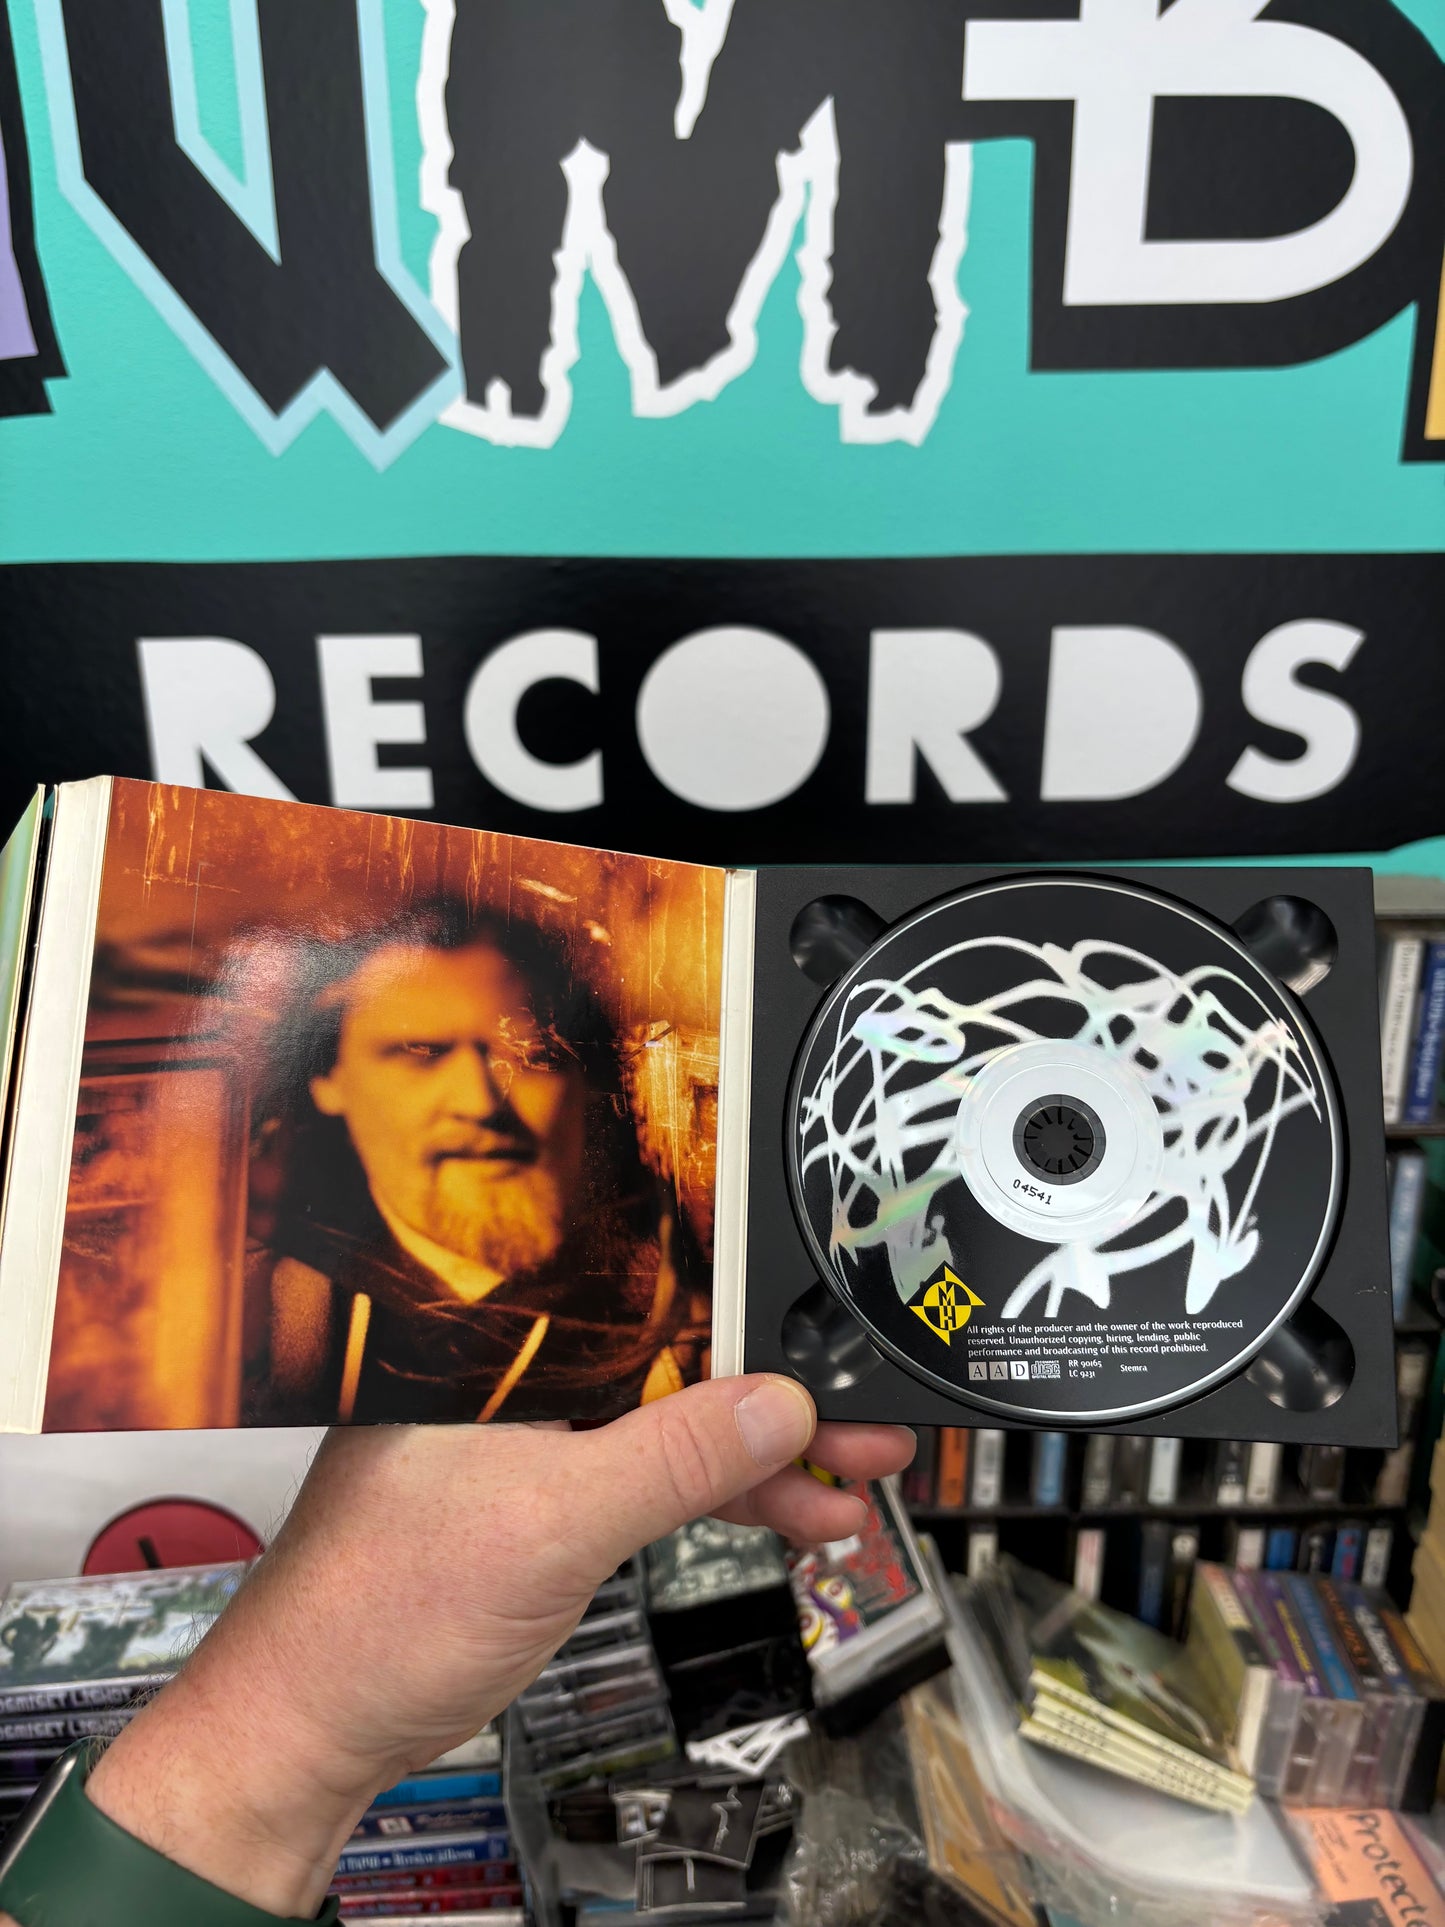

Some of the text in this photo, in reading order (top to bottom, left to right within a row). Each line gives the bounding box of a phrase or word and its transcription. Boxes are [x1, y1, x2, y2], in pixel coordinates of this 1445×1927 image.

[137, 618, 1366, 813] RECORDS
[1012, 1178, 1052, 1205] 04541
[967, 1320, 1244, 1336] All rights of the producer and the owner of the work reproduced
[967, 1336, 1006, 1345] reserved.
[1009, 1334, 1066, 1344] Unauthorized
[1173, 1332, 1201, 1342] public
[968, 1343, 1209, 1358] performance and broadcasting of this record prohibited.
[1080, 1359, 1102, 1368] 90165
[1120, 1364, 1148, 1372] Stemra
[1068, 1370, 1096, 1378] LC 9231
